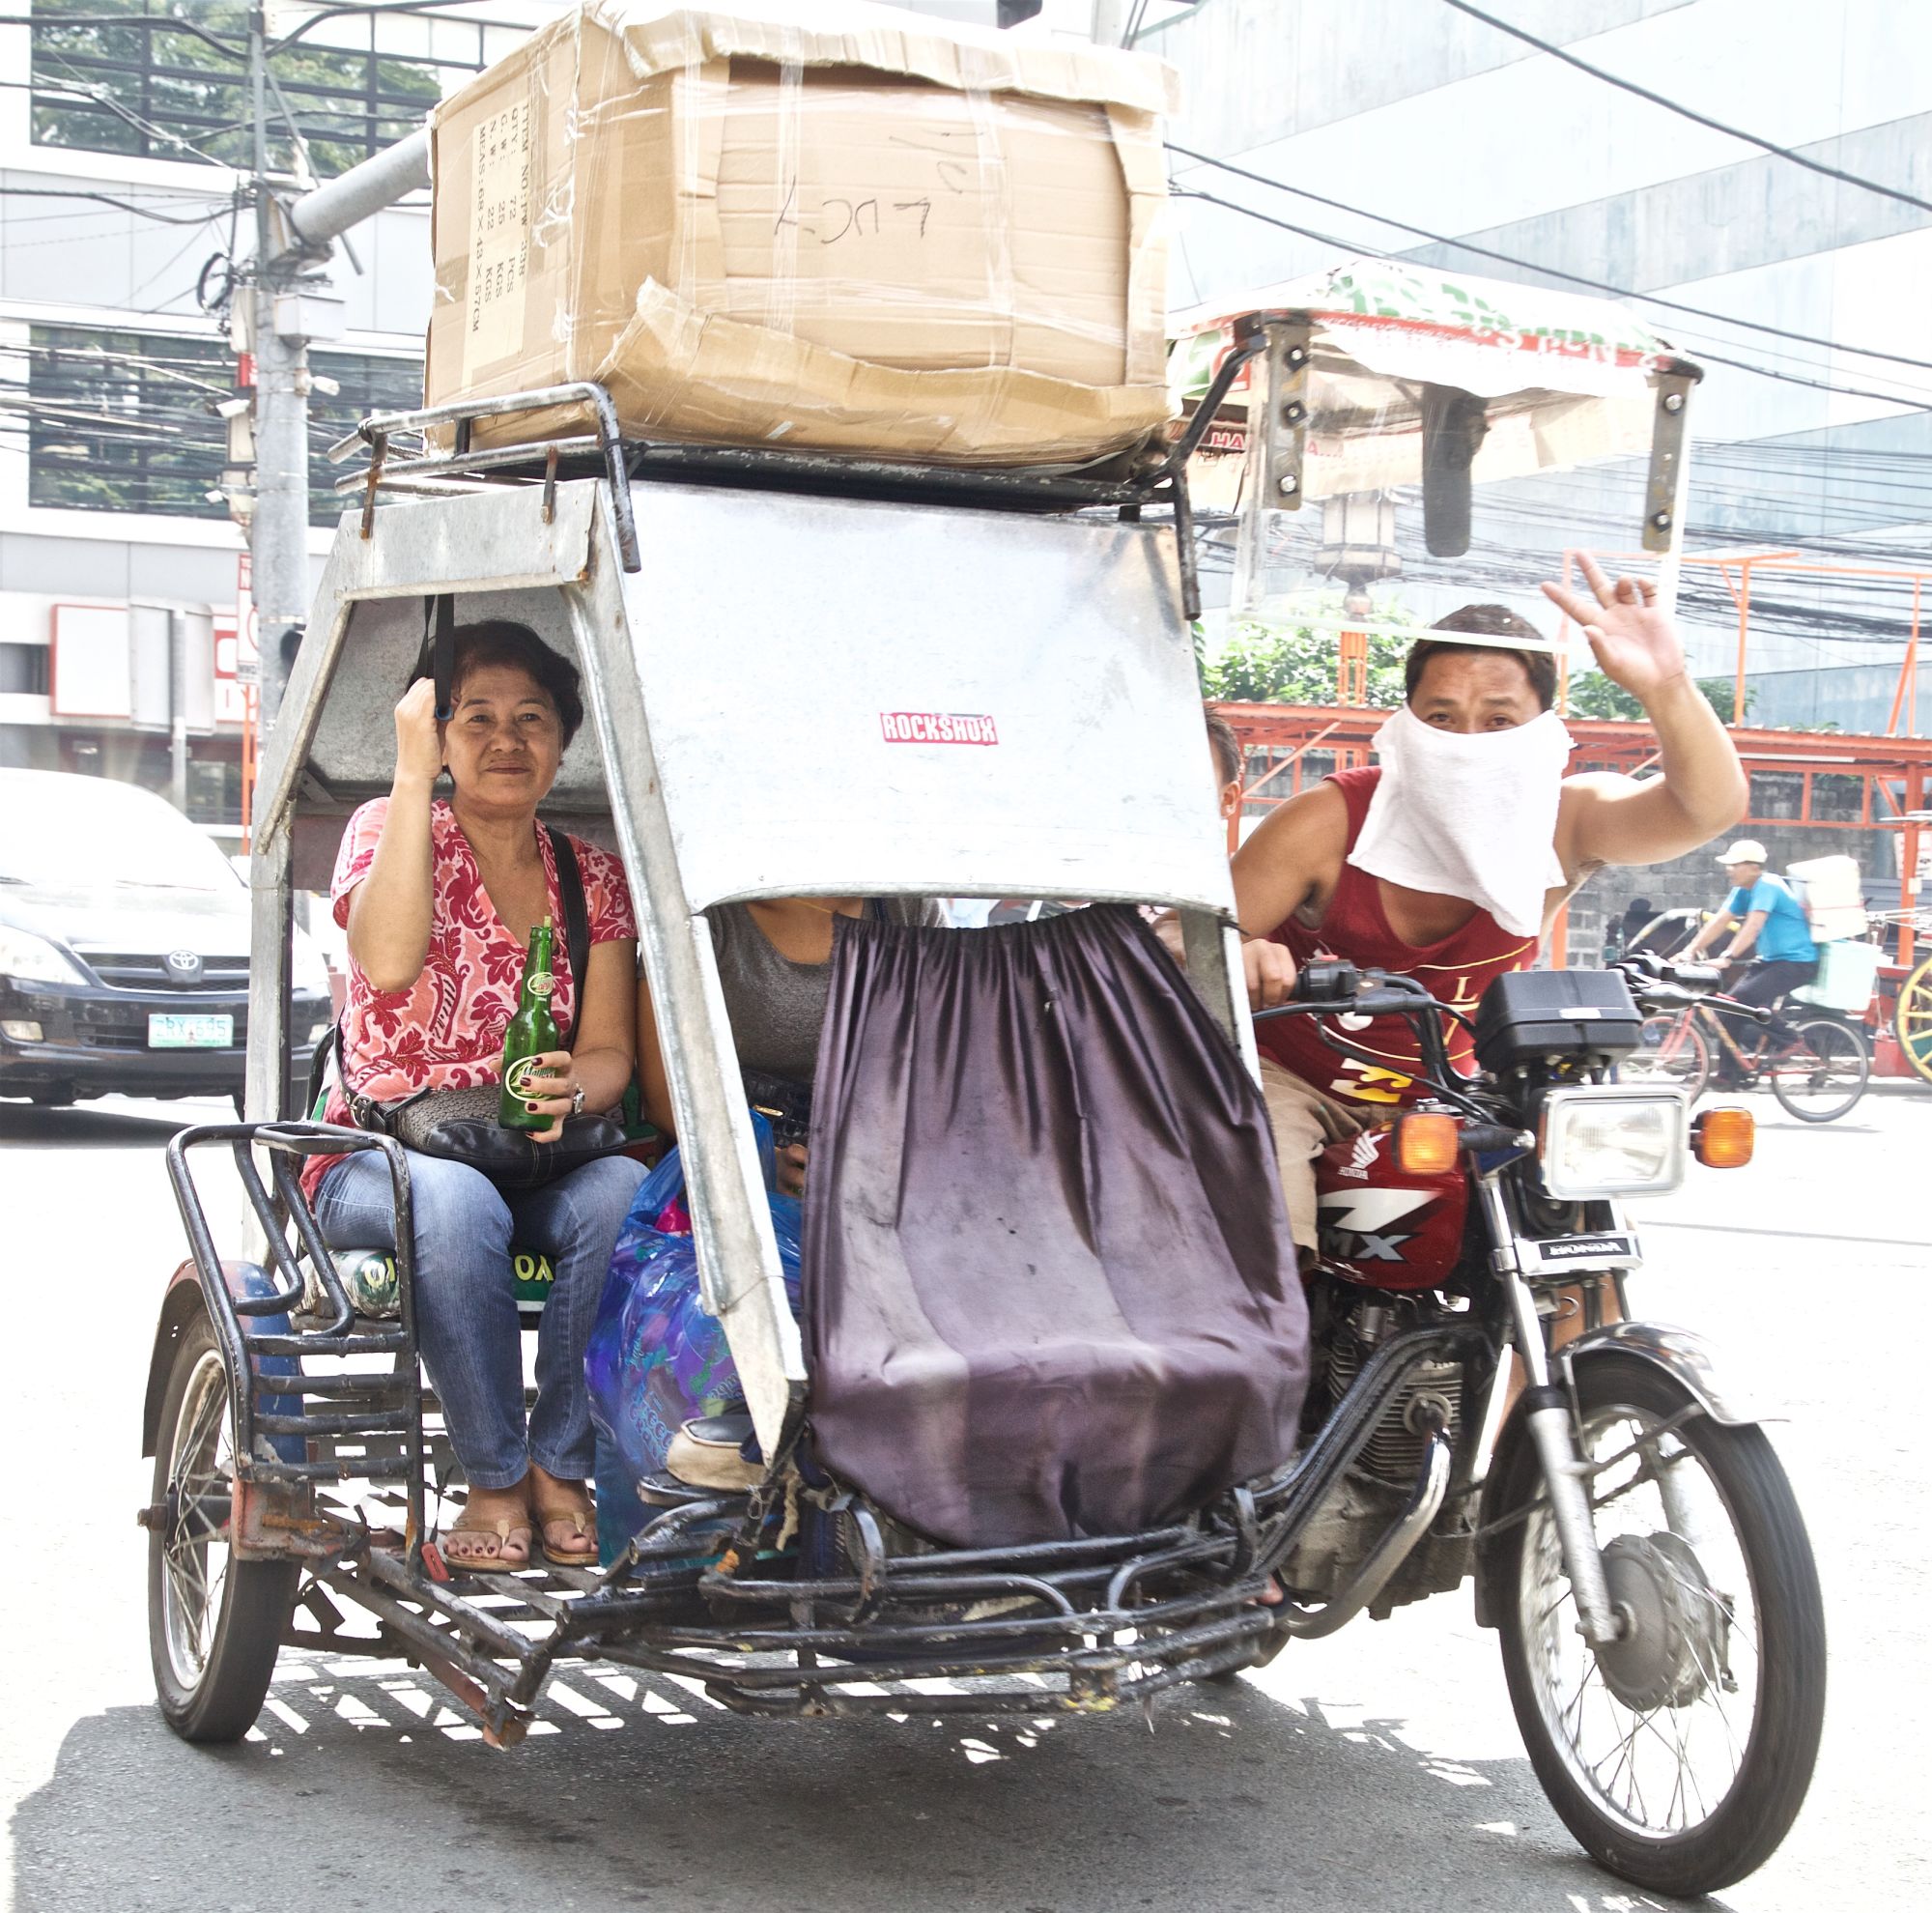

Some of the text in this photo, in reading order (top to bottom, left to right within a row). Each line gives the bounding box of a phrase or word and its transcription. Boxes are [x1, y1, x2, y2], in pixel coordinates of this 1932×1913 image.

[497, 200, 506, 225] 25
[507, 107, 519, 294] QTY: 72 PCS
[487, 207, 495, 231] 22
[484, 266, 493, 302] KGS
[496, 262, 504, 299] KGS
